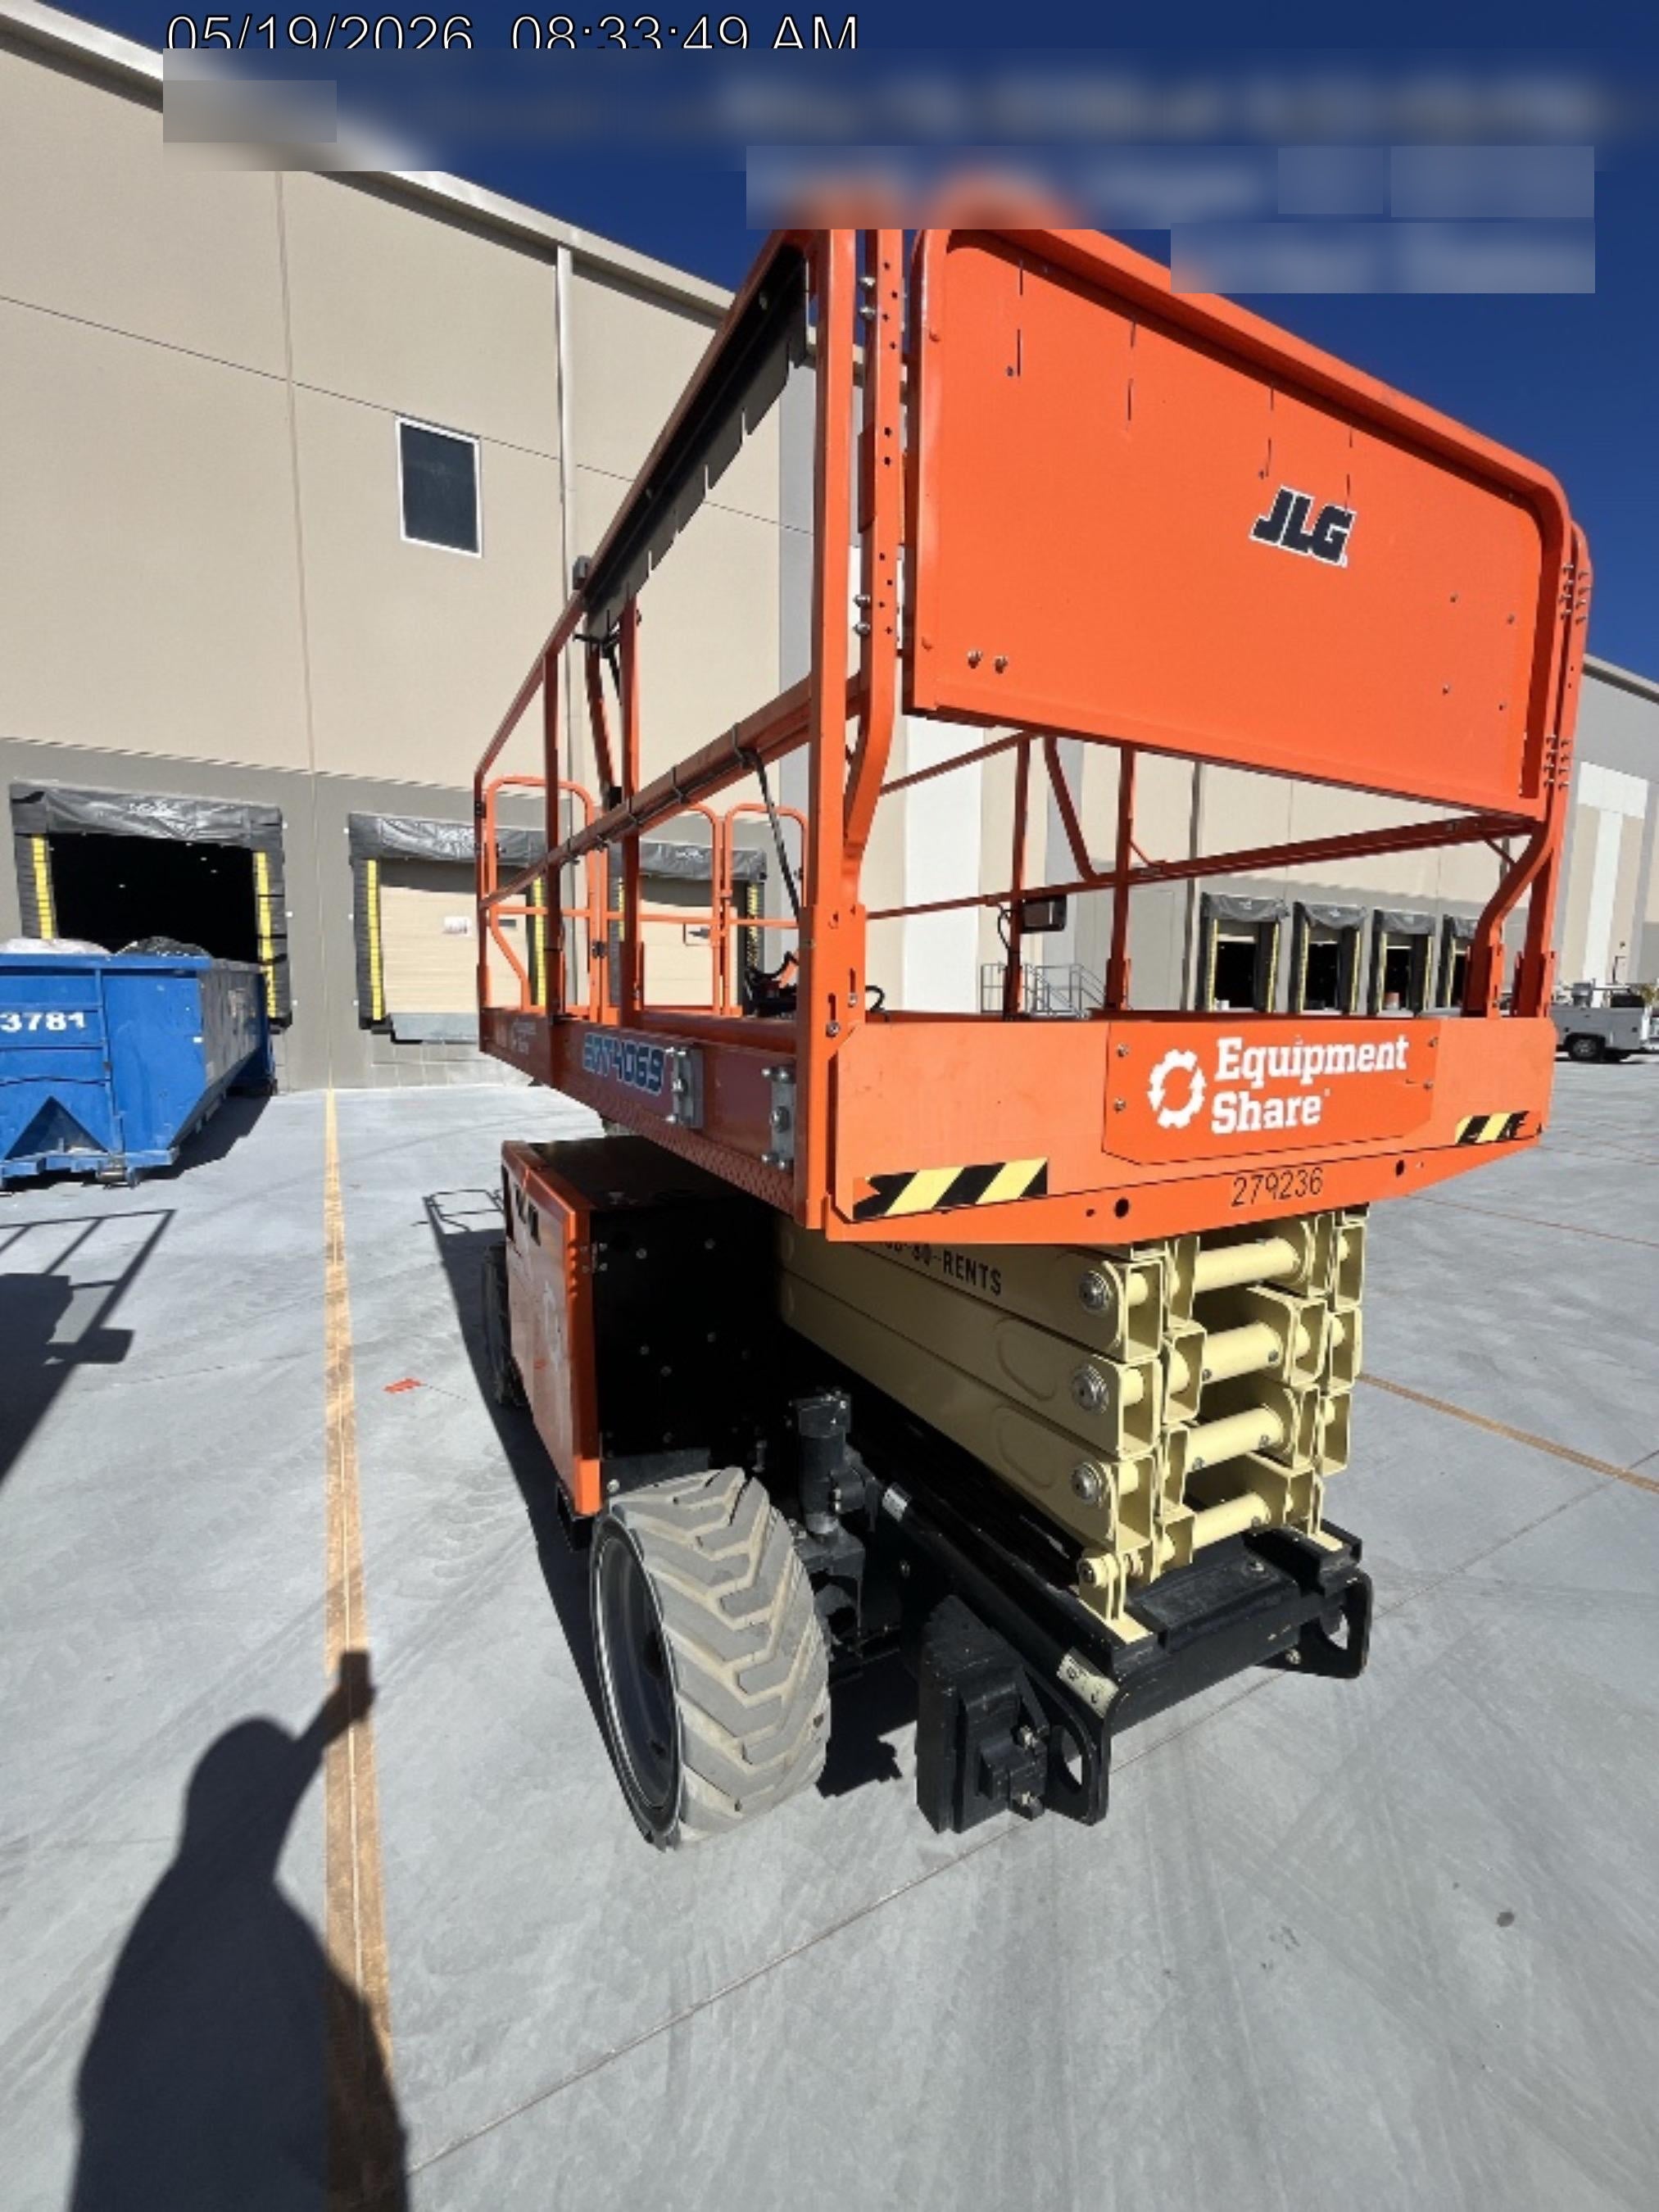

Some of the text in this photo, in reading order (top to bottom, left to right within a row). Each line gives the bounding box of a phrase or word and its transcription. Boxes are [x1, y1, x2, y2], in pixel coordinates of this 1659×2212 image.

[1249, 485, 1357, 567] JLG
[0, 1012, 85, 1032] 3781
[1215, 1035, 1409, 1089] Equipment
[1212, 1090, 1321, 1134] Share
[1231, 1167, 1323, 1207] 279236
